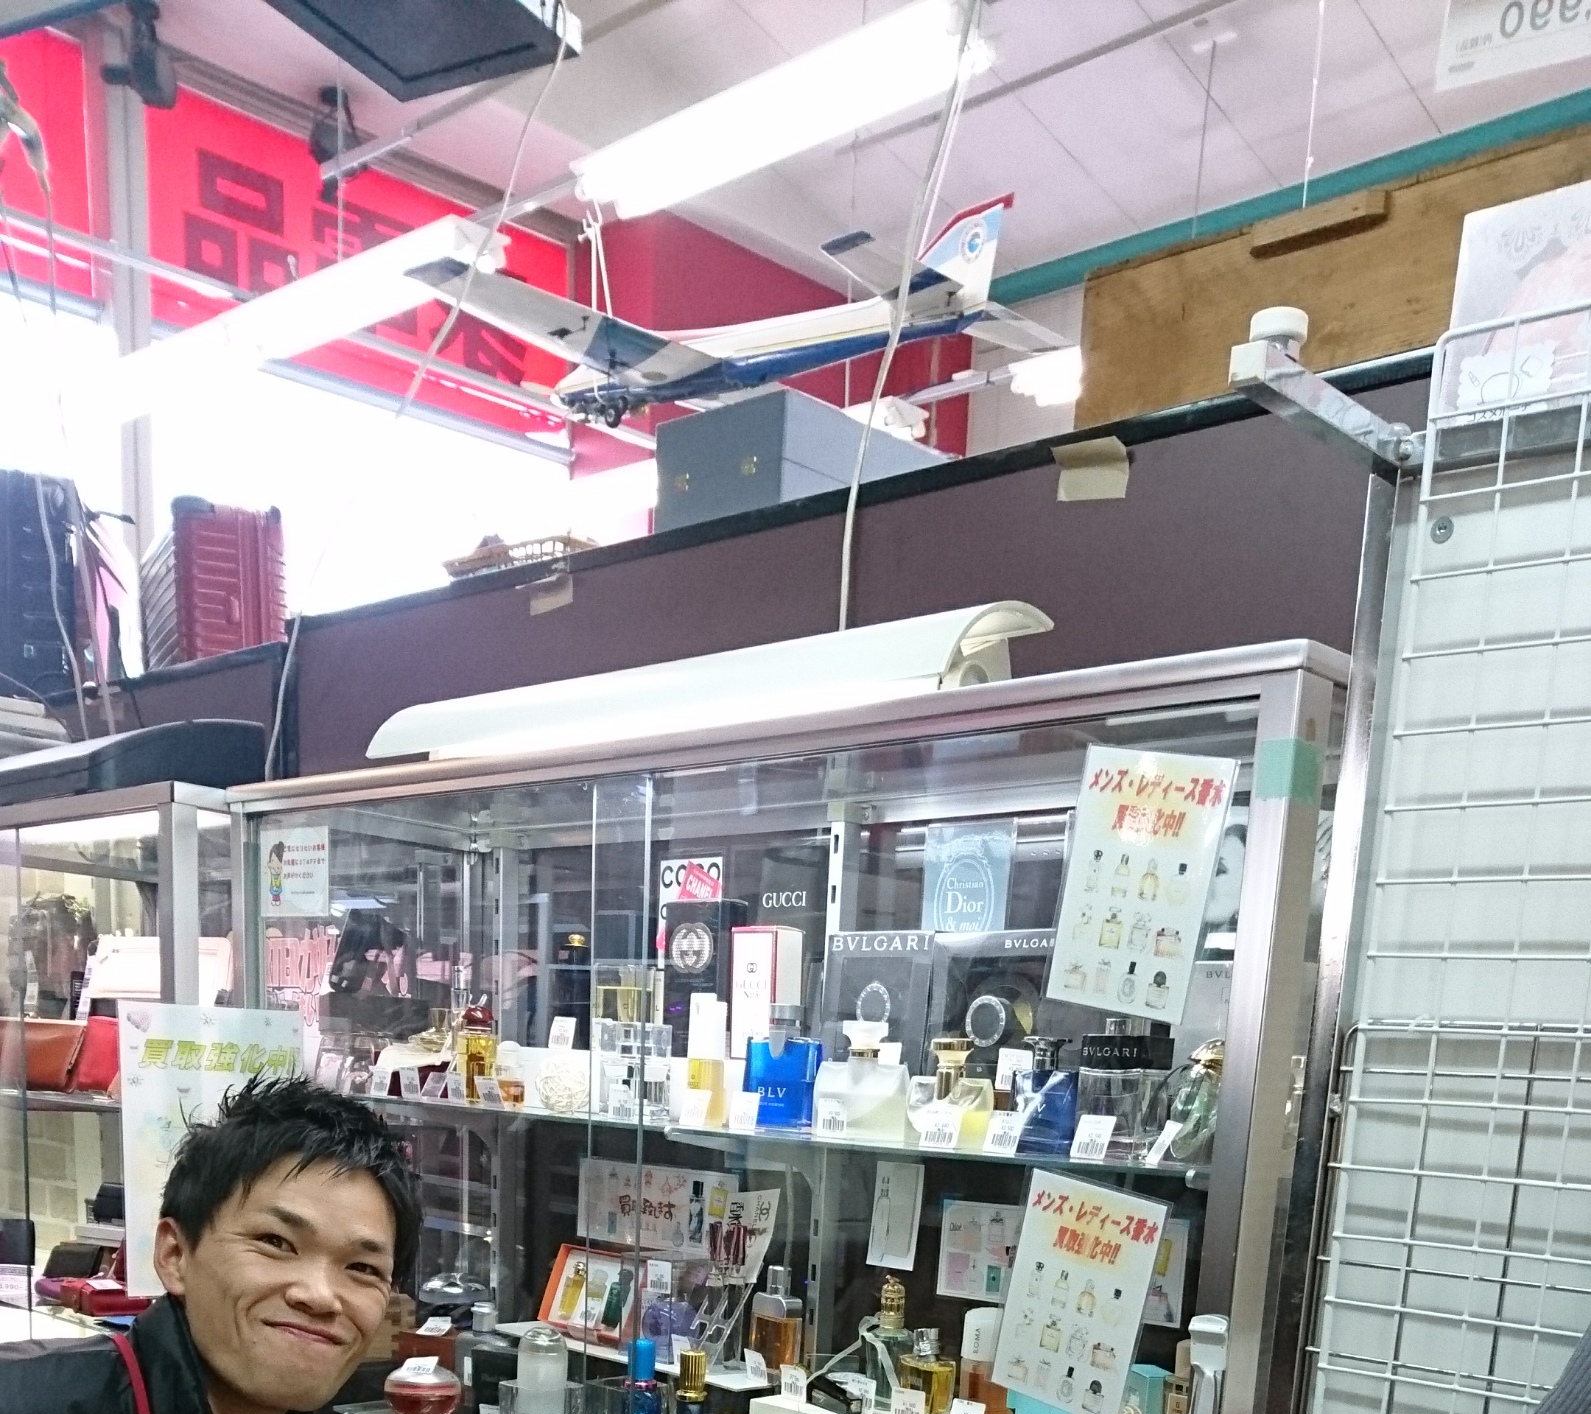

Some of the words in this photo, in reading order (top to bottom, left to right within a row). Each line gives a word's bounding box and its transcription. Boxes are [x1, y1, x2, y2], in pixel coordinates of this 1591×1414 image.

[661, 862, 721, 889] COO
[946, 877, 984, 890] Christian
[762, 891, 807, 908] GUCCI
[944, 891, 984, 915] Dior
[832, 935, 930, 952] BVLGARI
[1004, 938, 1056, 950] BVLGA
[1082, 1046, 1137, 1058] BVLGARI
[757, 1085, 787, 1099] BLV
[1032, 1189, 1159, 1245] メンズ・レディース香水
